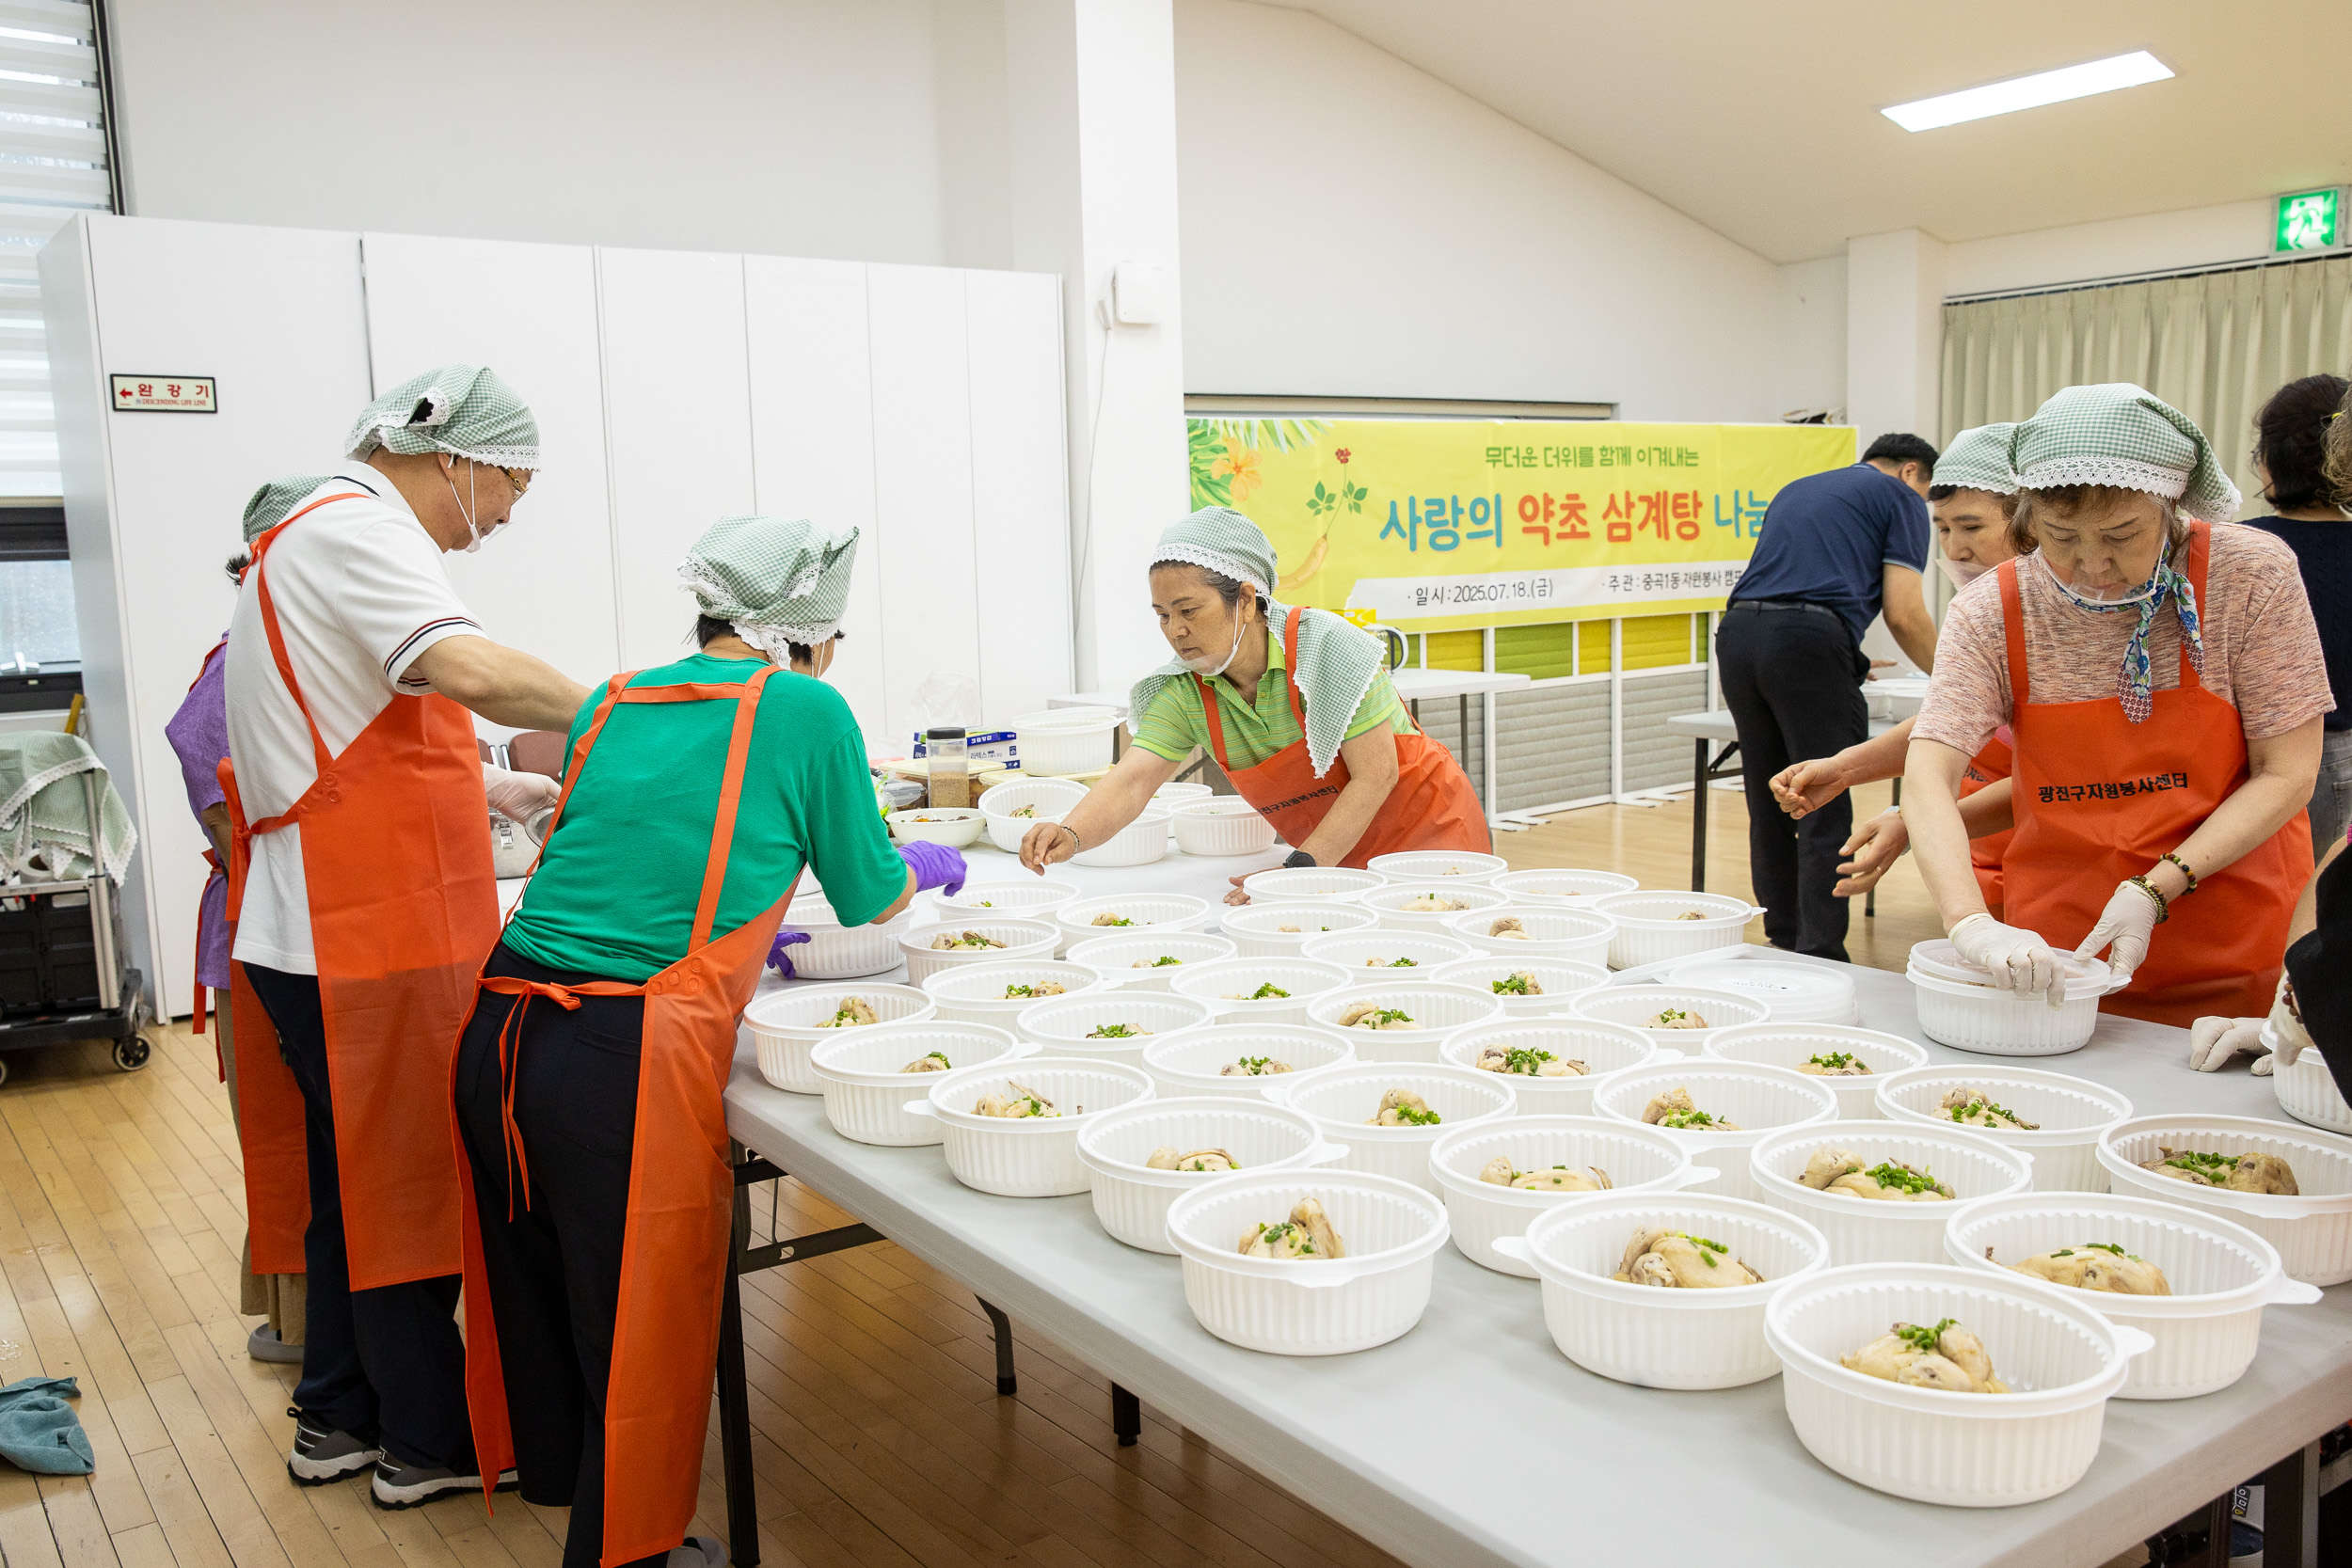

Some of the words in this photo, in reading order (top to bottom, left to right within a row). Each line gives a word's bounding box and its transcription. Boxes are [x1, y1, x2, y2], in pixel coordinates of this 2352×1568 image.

[1486, 446, 1538, 468] 무더운
[1544, 446, 1594, 468] 더위를
[1599, 446, 1632, 467] 함께
[1637, 446, 1699, 467] 이겨내는
[1379, 493, 1502, 552] 사랑의
[1518, 492, 1591, 546] 약초
[1602, 489, 1703, 543] 삼계탕
[1714, 489, 1768, 539] 나눔
[2038, 772, 2188, 803] 광진구자원봉사센터
